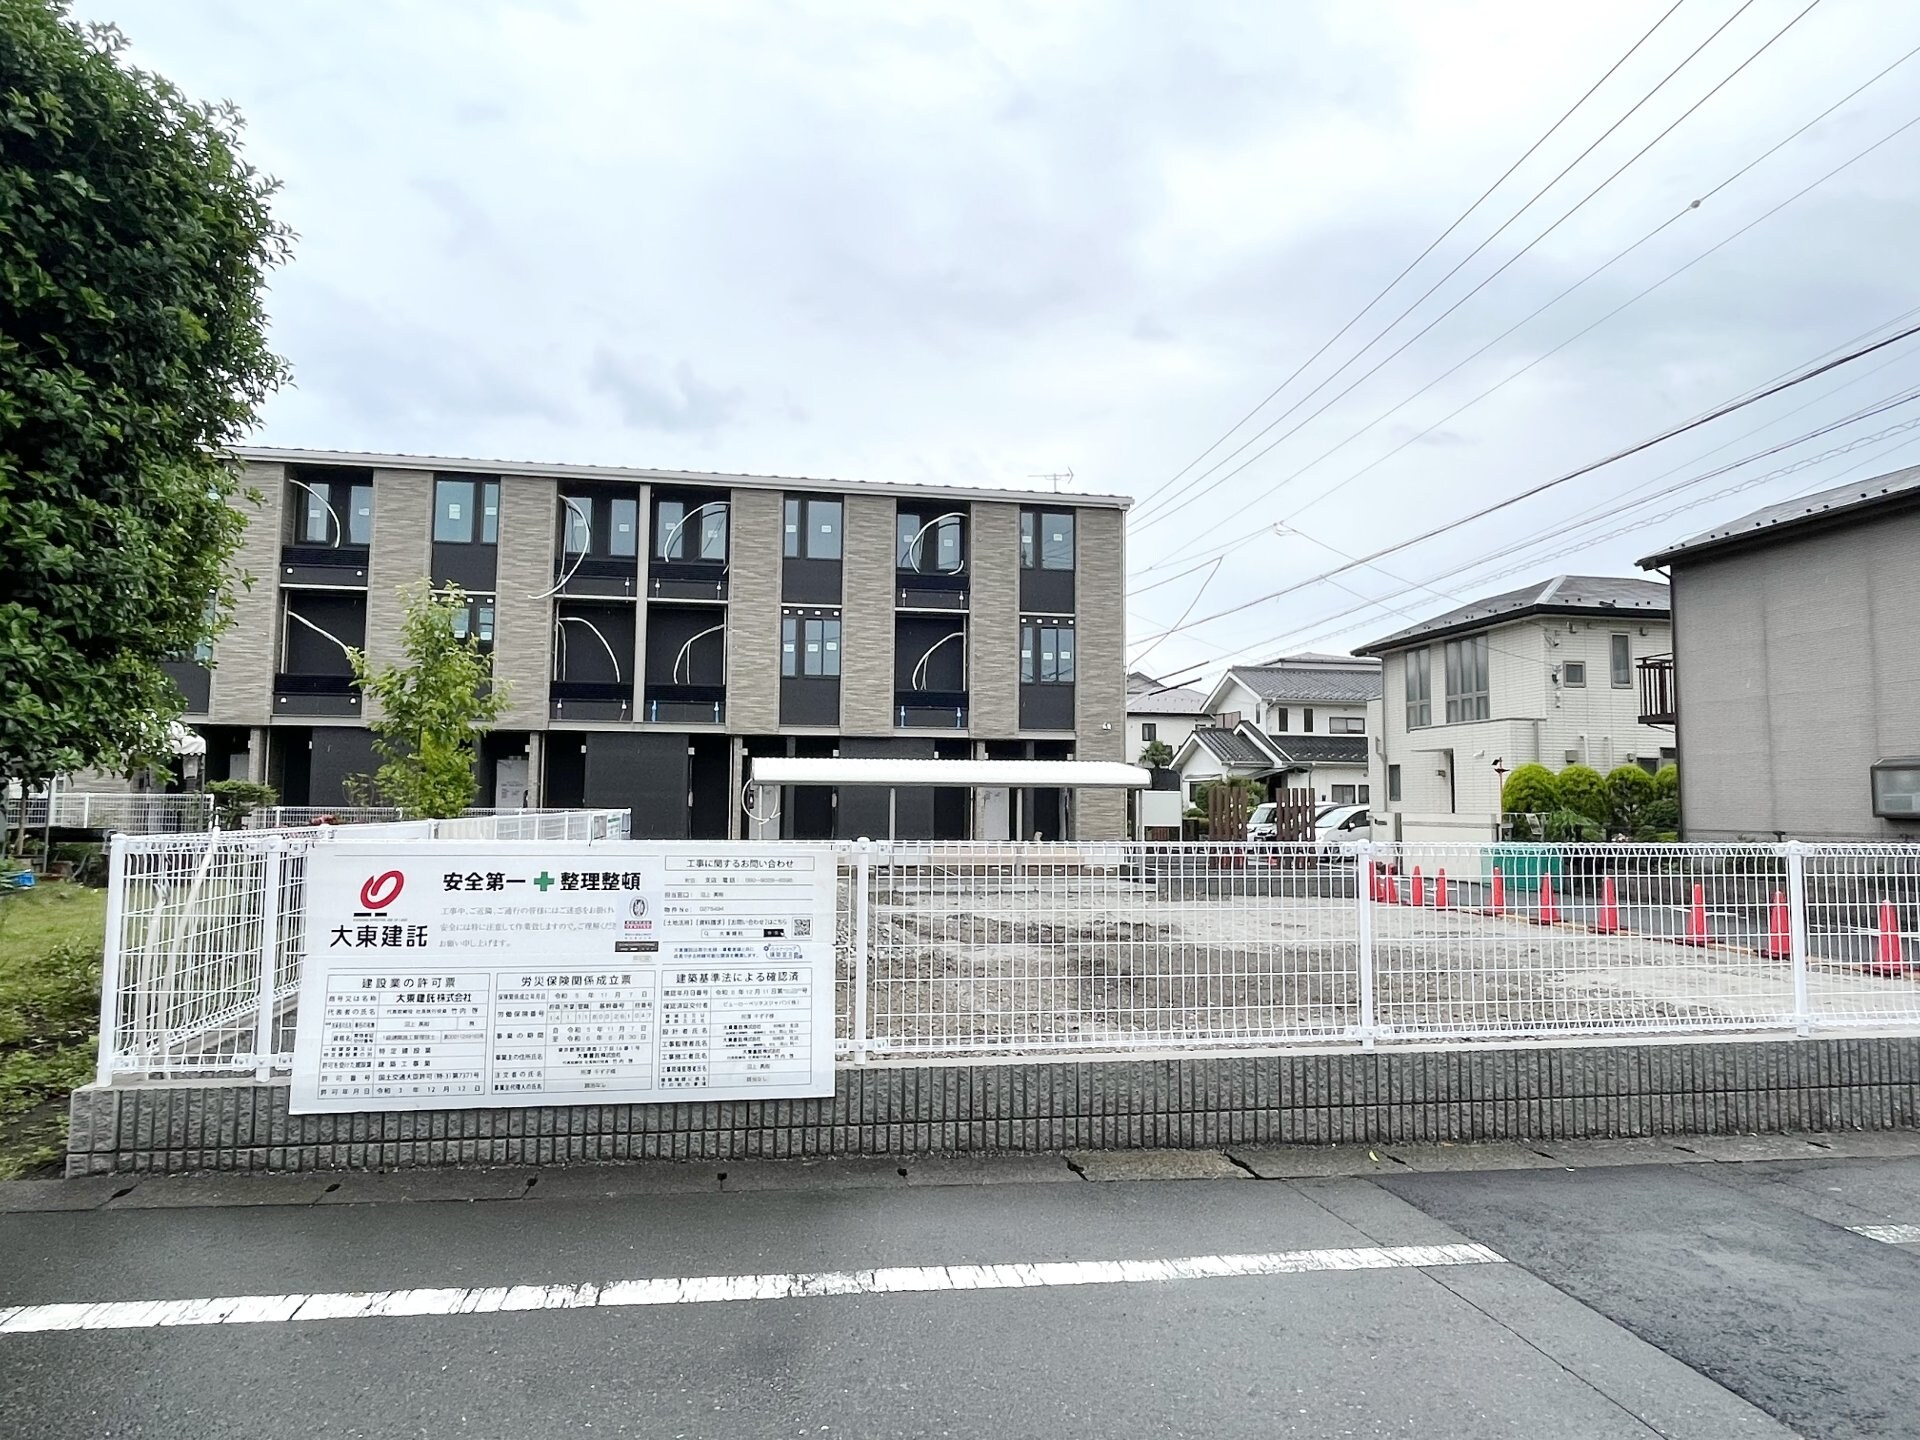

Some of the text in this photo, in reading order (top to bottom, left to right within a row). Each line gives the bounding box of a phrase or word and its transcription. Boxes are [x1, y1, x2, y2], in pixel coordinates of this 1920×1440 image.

[686, 859, 794, 868] 工事に関するお問い合わせ
[443, 871, 641, 892] 安全第一 整理整頓
[330, 924, 428, 948] 大東建託
[362, 977, 456, 989] 建設業の許可票
[521, 975, 632, 987] 労災保険関係成立票
[676, 971, 799, 984] 建築基準法による確認済
[396, 993, 472, 1003] 大東建託株式会社
[327, 1008, 376, 1016] 代表者の氏名
[320, 1087, 370, 1095] 許可年月日
